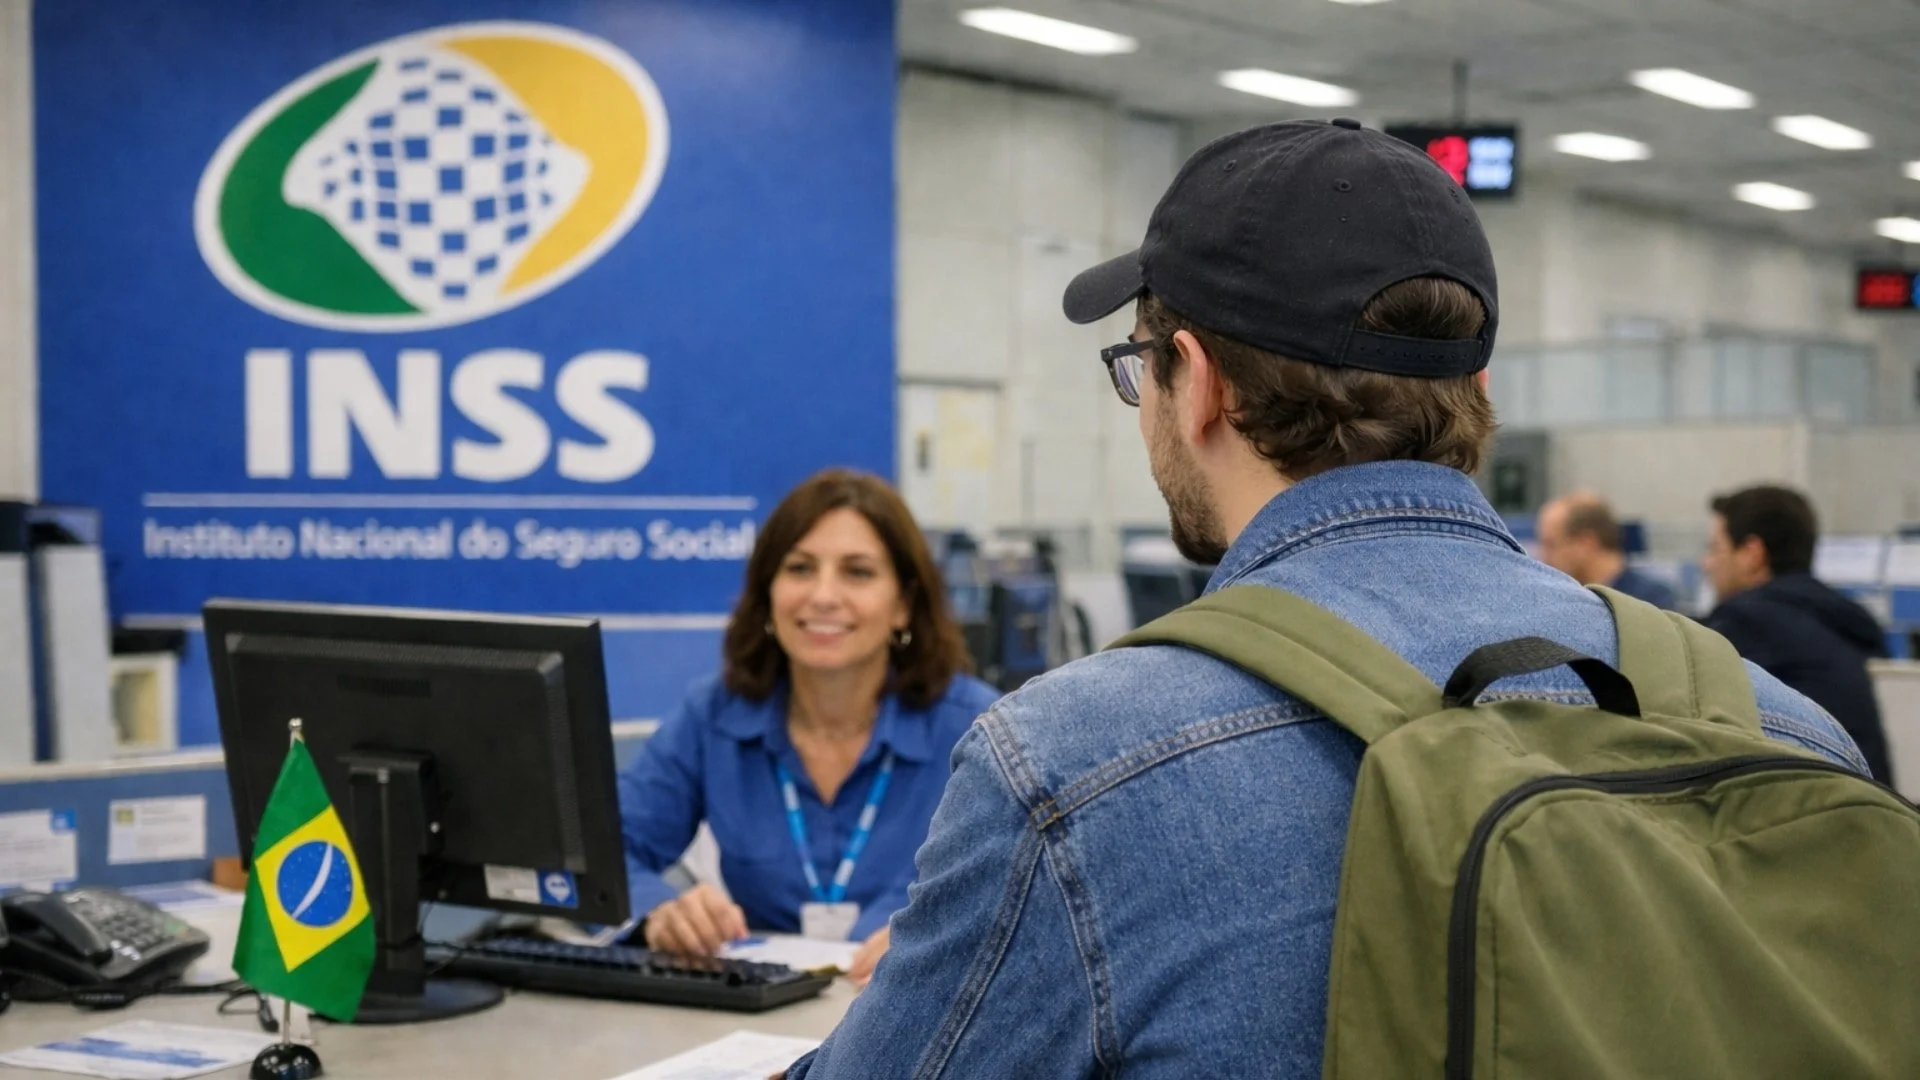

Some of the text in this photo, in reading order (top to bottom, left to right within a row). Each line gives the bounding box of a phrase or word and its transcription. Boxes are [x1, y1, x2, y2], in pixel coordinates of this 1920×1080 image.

[246, 349, 654, 482] INSS
[144, 518, 756, 568] Instituto Nacional do Seguro Social
